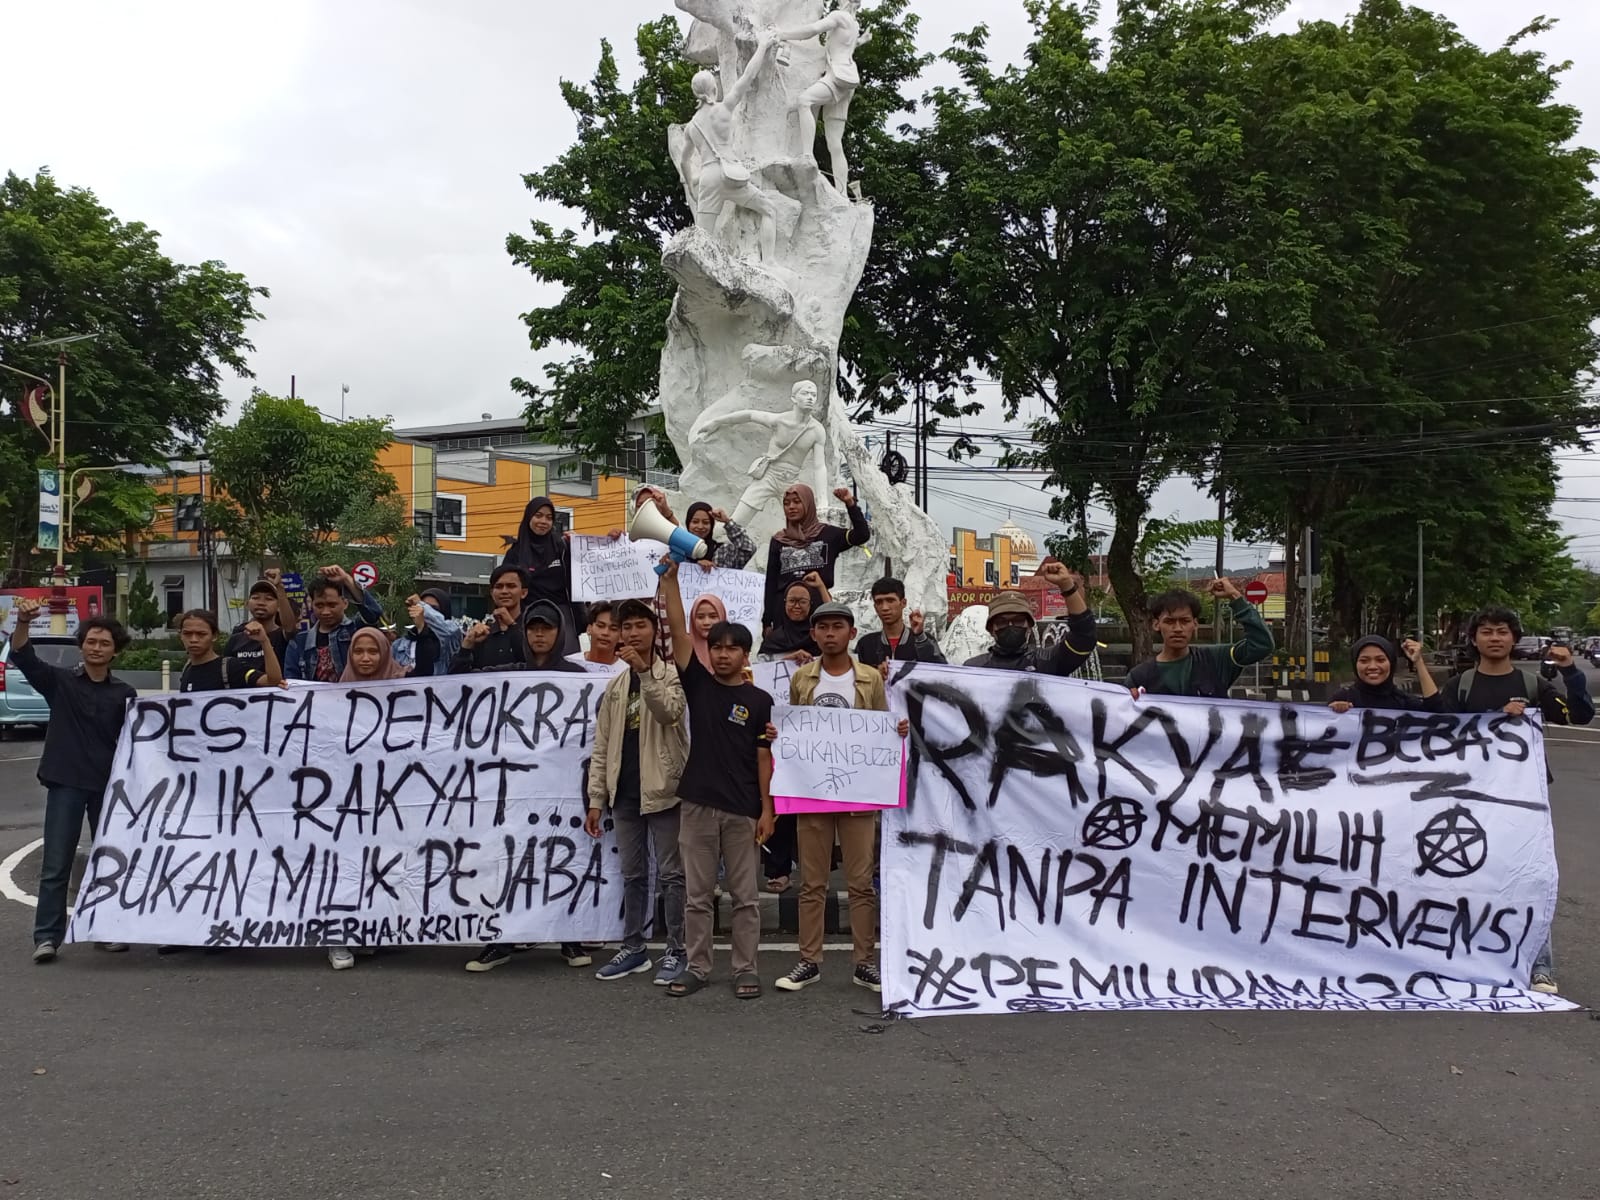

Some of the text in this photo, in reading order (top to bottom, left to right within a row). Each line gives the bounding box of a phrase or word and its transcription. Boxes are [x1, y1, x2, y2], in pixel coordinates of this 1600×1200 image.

[126, 681, 605, 768] PESTA DEMOKRA
[781, 710, 898, 734] KAMI DISIN
[1356, 708, 1541, 770] BEBAS
[102, 767, 274, 842] MILIK
[1152, 799, 1386, 887] MEMILIH
[77, 836, 625, 919] BUKAN MILIK PEJABA
[898, 831, 1534, 968] TANPA INTERVENSI
